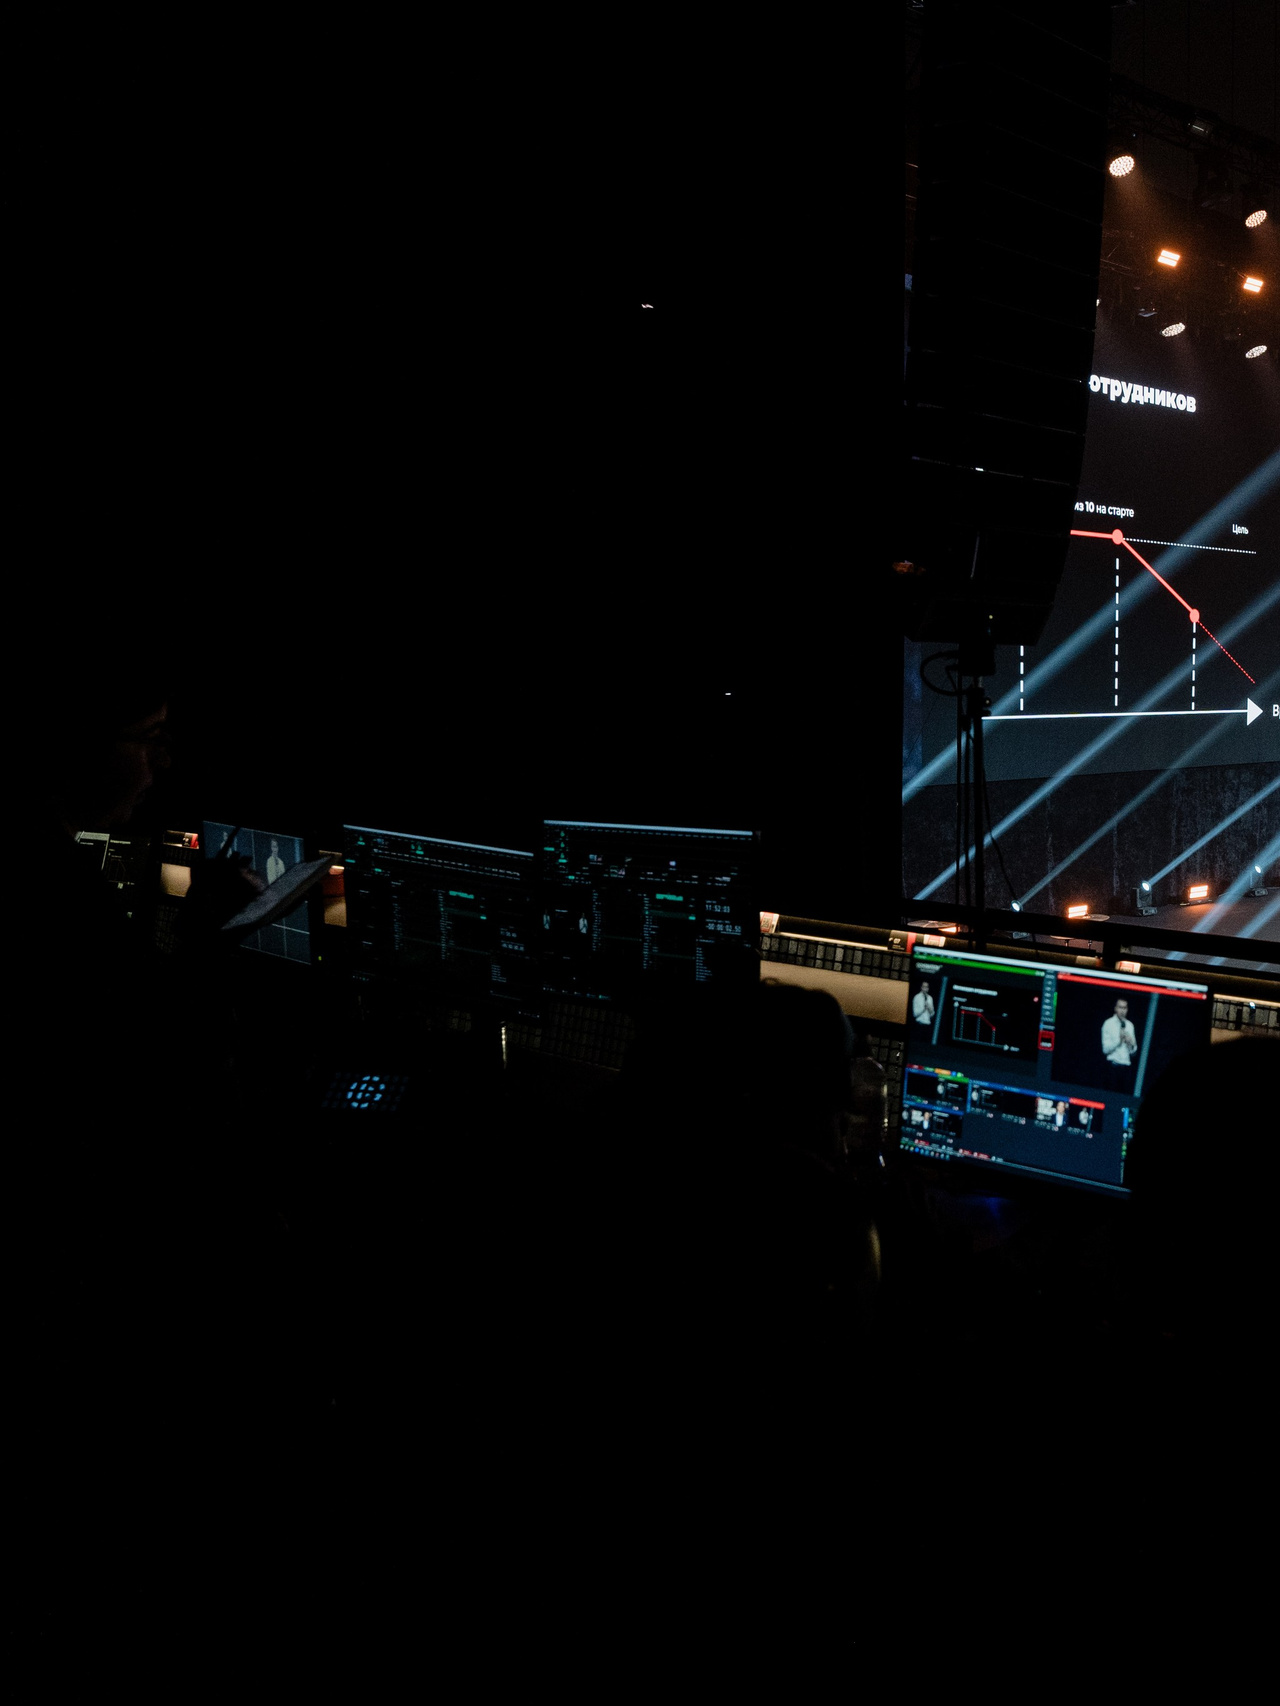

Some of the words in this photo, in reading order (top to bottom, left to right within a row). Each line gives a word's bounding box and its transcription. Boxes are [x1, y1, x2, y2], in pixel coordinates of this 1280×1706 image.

[1089, 374, 1196, 413] отрудников
[1085, 501, 1095, 513] 10
[1096, 504, 1107, 514] на
[1107, 505, 1135, 518] старте
[1232, 523, 1249, 535] Цель
